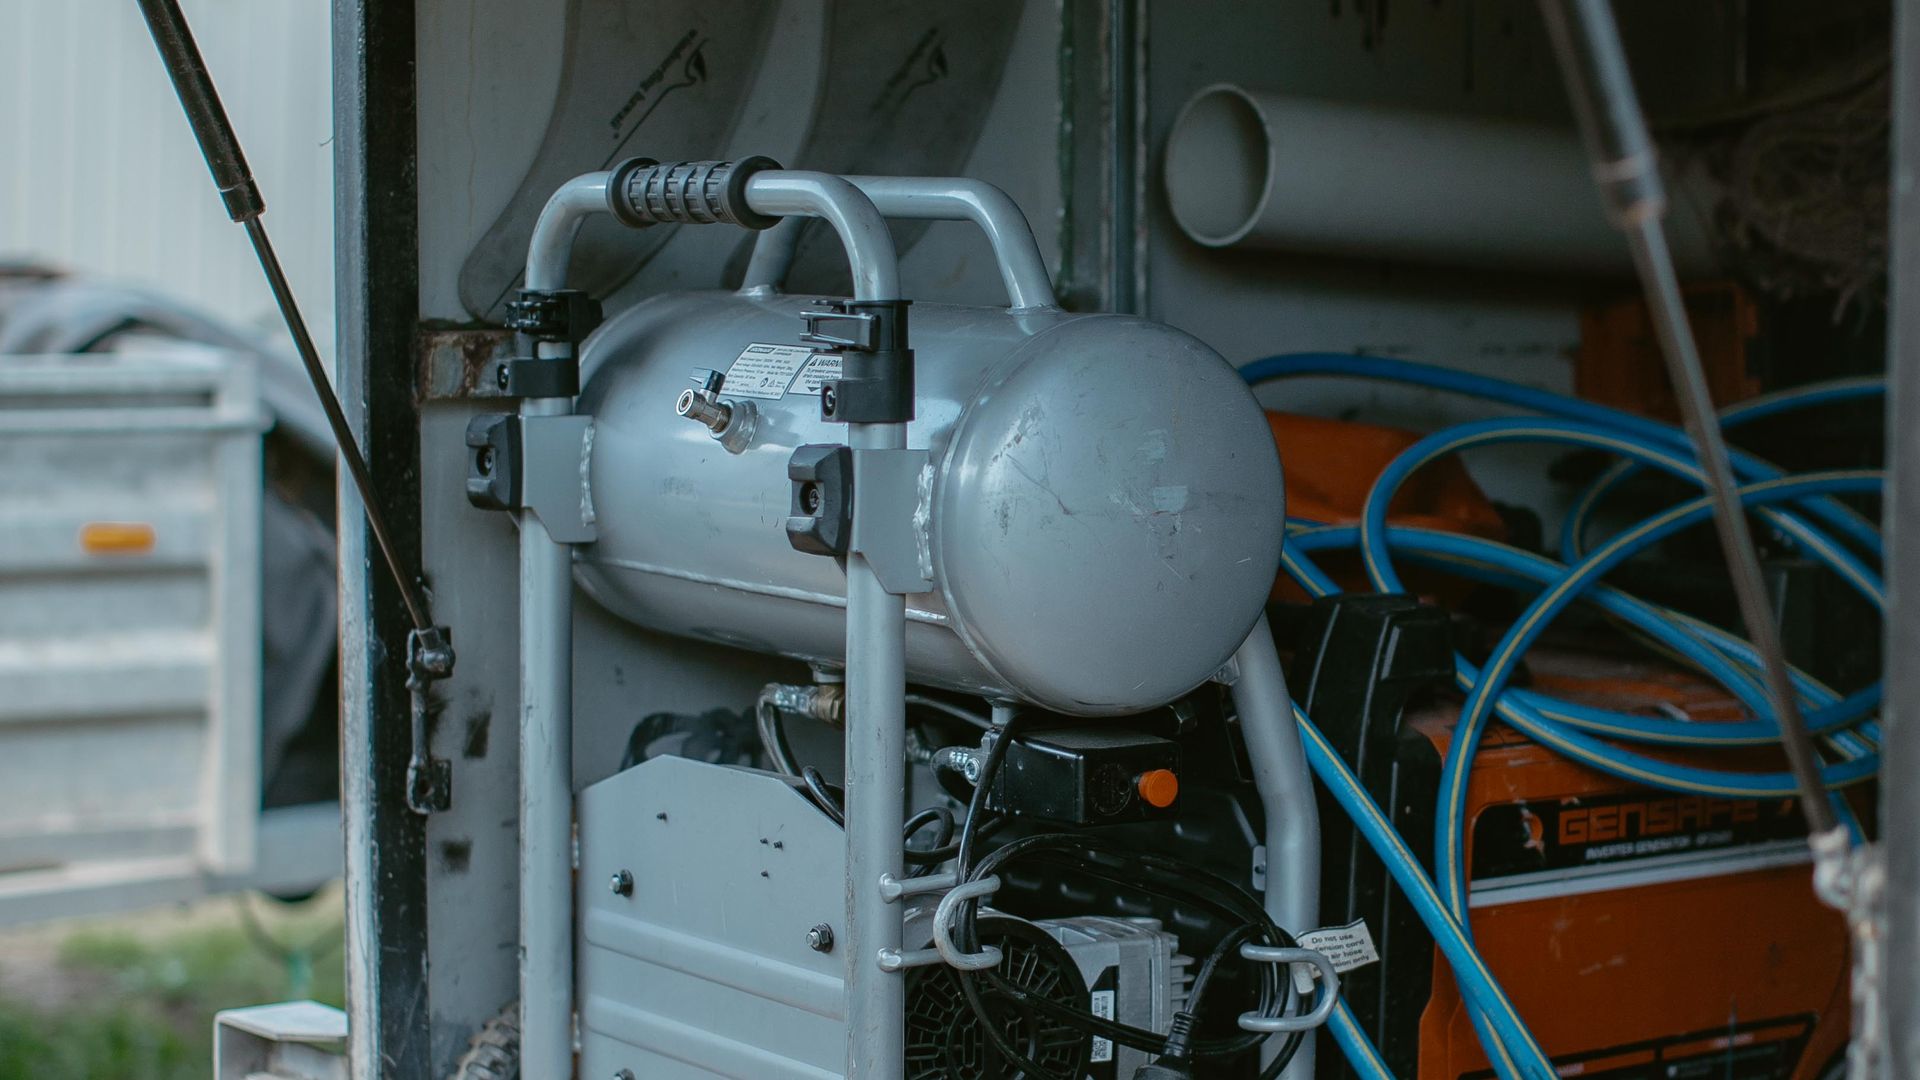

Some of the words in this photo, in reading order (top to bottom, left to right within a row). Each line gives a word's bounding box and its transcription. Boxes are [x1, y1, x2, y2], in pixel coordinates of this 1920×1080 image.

[1559, 796, 1759, 845] GENSAFE
[1585, 843, 1634, 860] INVERTER
[1345, 939, 1365, 948] cord
[1343, 949, 1363, 957] hose
[1352, 954, 1370, 963] only
